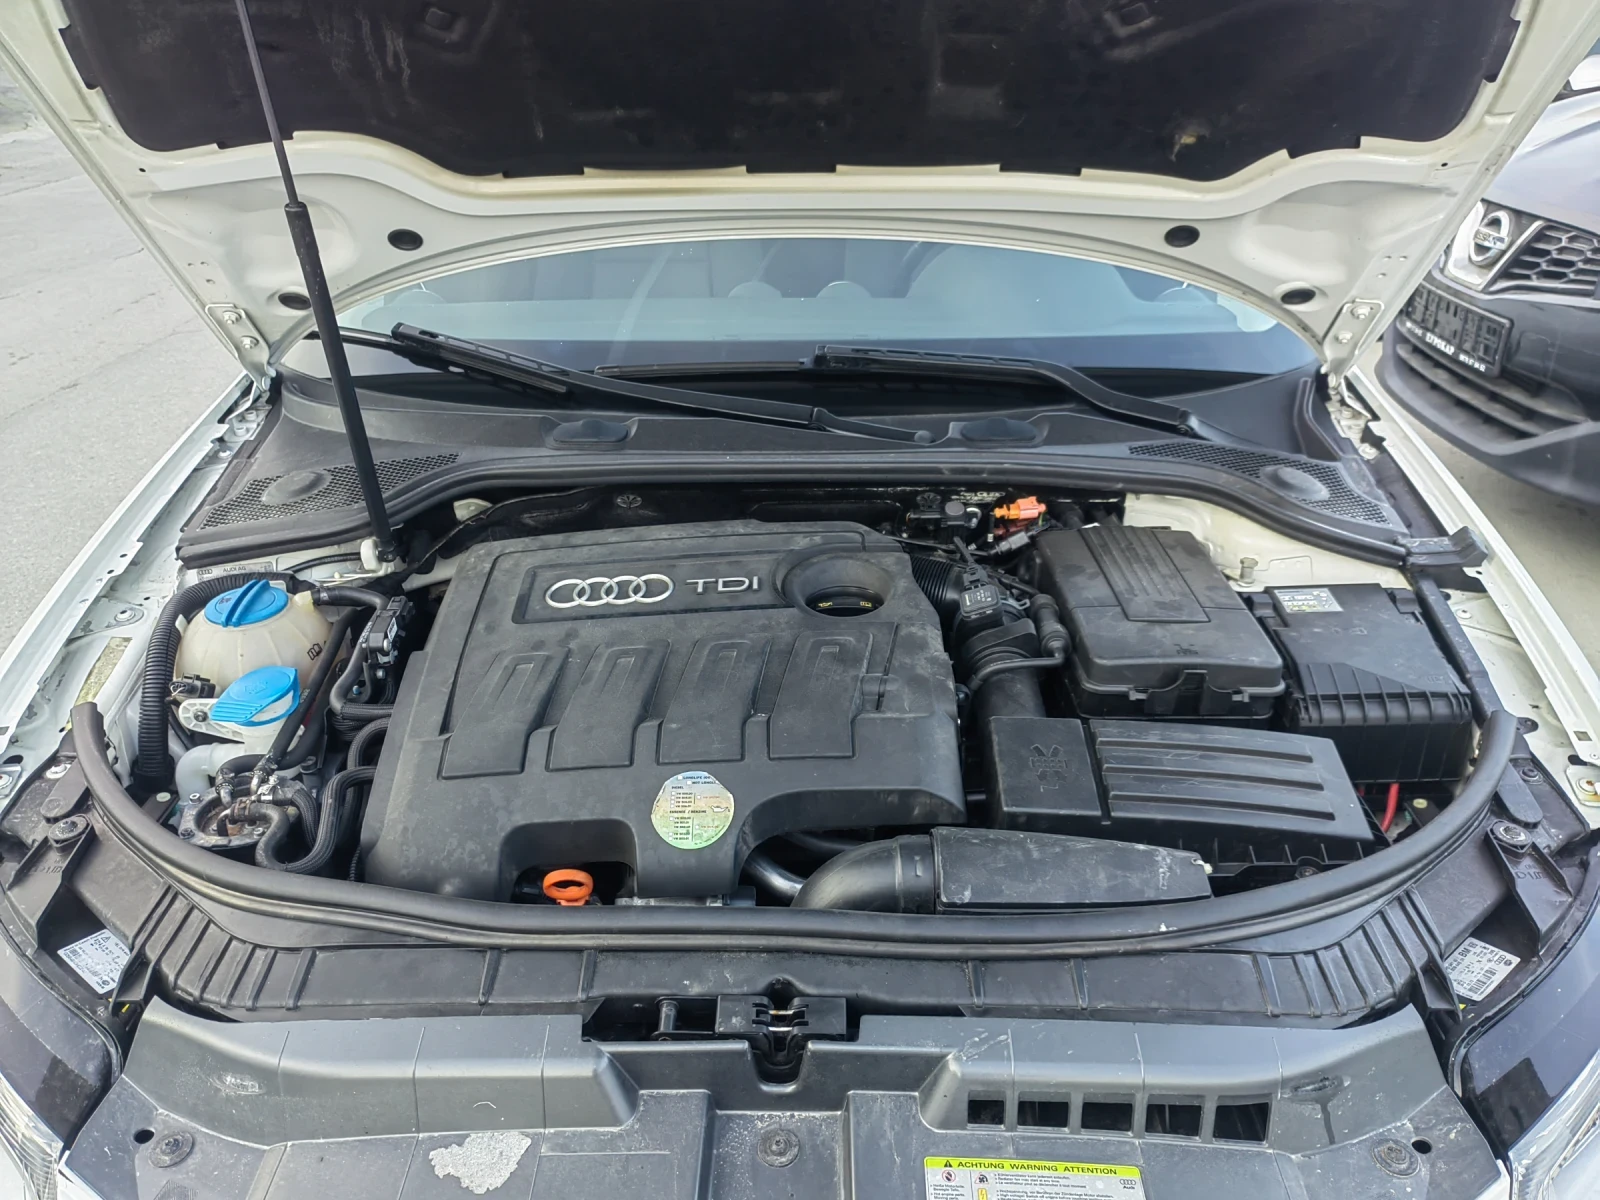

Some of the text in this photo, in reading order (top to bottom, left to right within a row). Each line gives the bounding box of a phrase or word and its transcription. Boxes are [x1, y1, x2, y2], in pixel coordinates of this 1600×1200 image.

[686, 575, 759, 594] TDI
[1010, 1163, 1058, 1171] WARNING
[1064, 1166, 1117, 1175] ATTENTION
